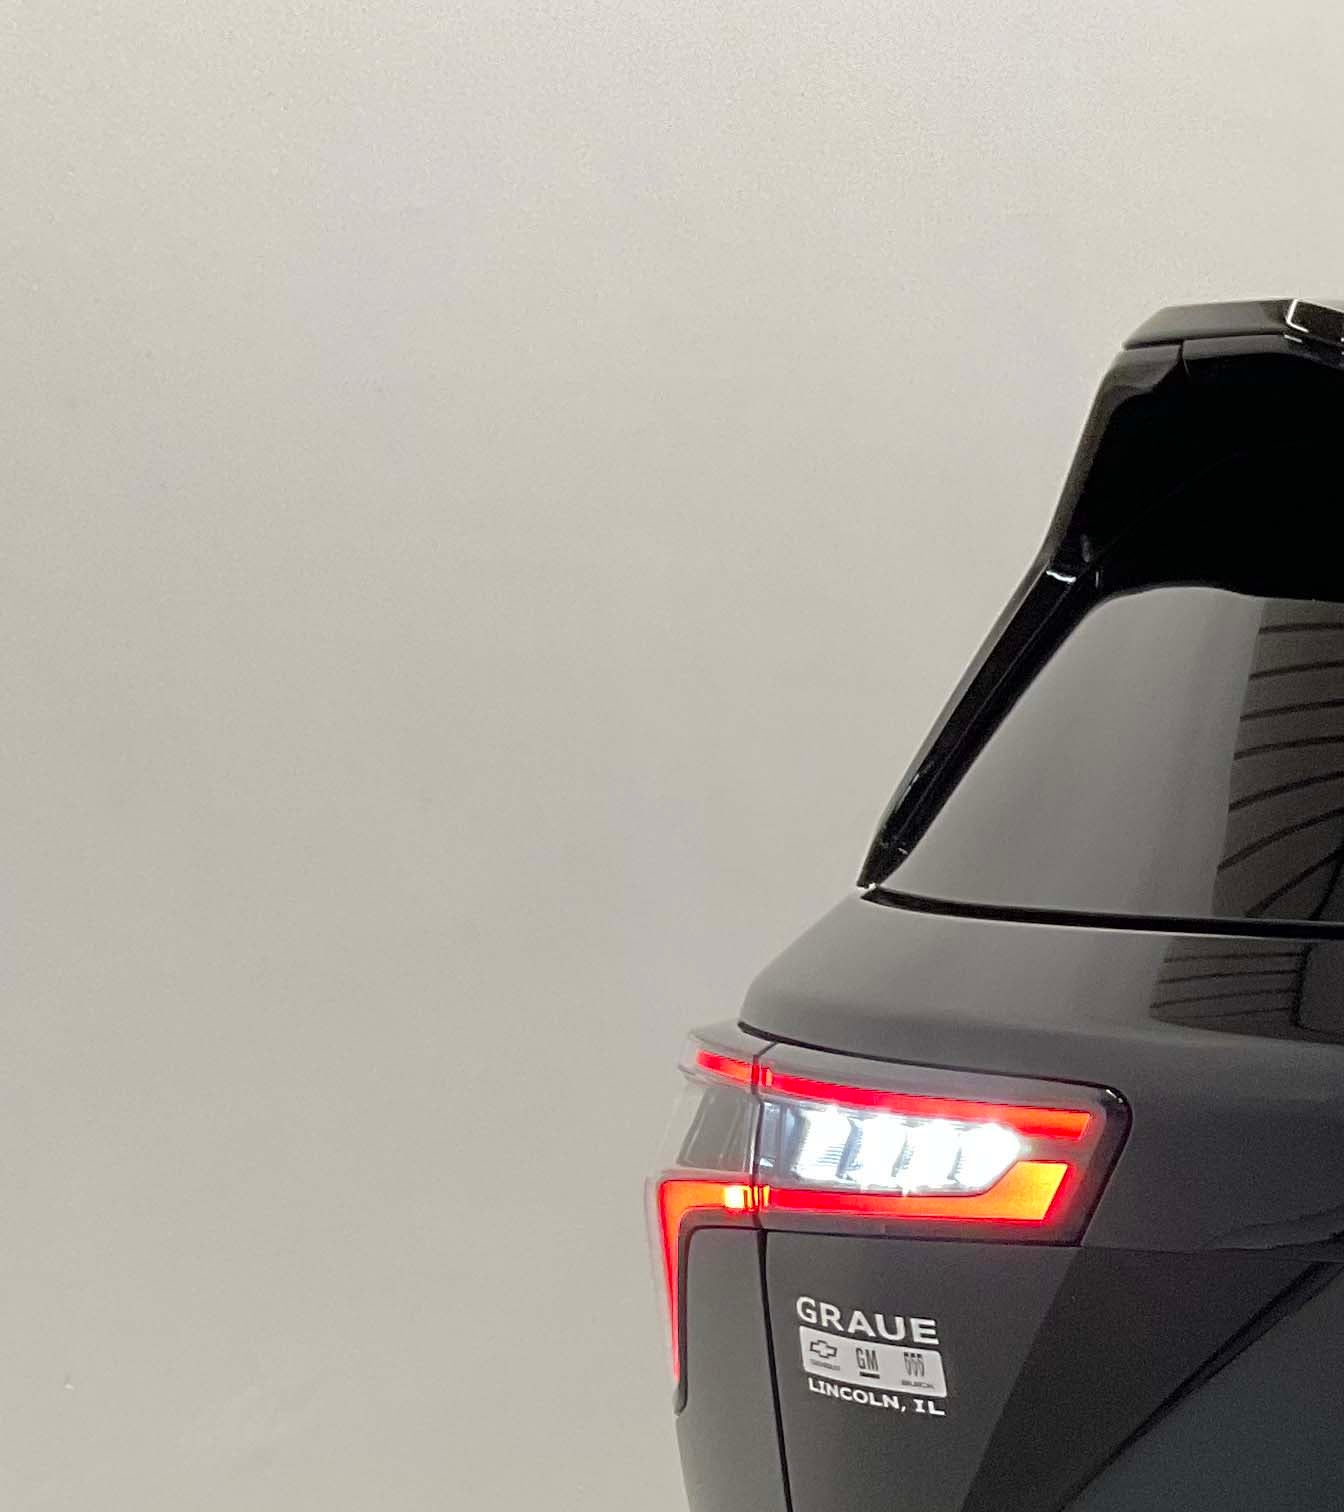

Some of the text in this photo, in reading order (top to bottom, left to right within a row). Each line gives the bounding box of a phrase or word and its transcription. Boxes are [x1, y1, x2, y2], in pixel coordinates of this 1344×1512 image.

[796, 1296, 939, 1345] GRAUE
[808, 1377, 945, 1416] LINCOLN, IL
